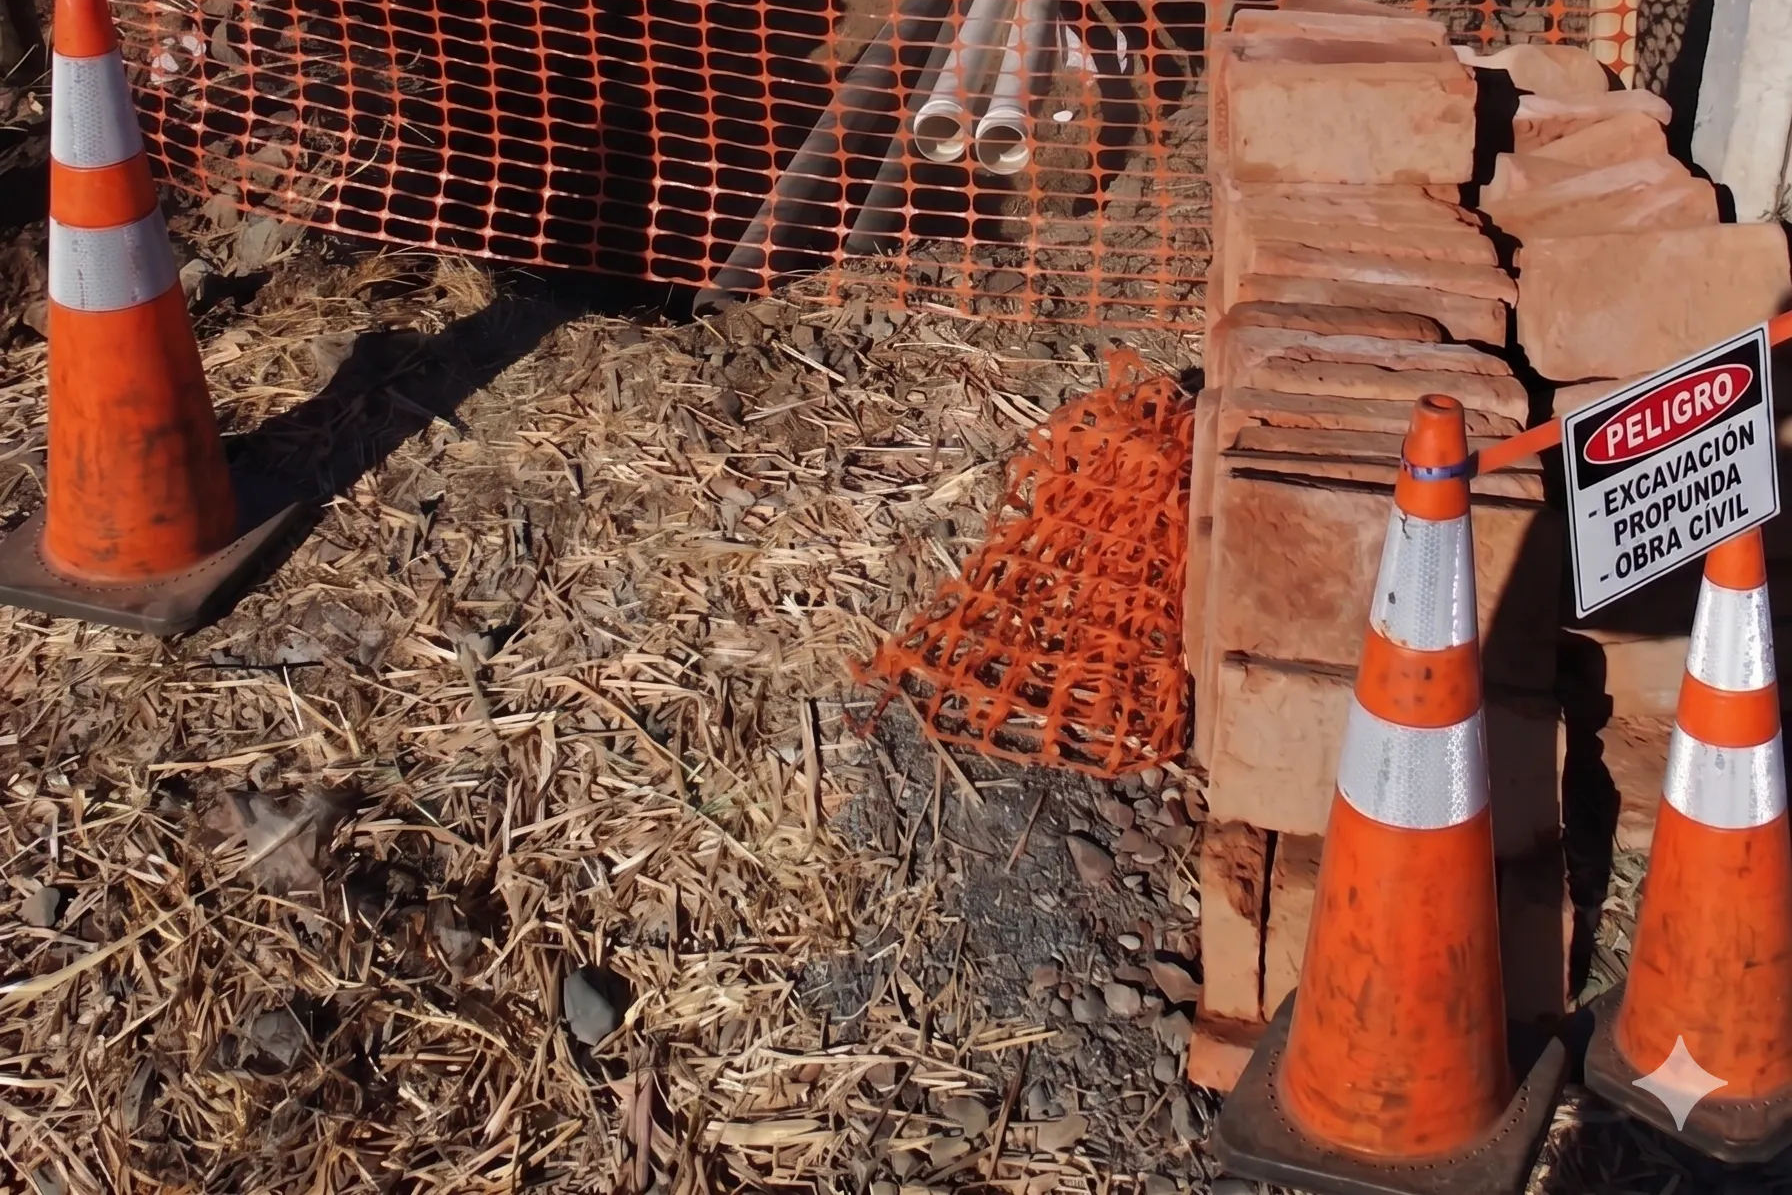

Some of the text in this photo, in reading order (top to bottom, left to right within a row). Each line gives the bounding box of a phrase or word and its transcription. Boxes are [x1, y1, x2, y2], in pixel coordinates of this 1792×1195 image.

[1606, 372, 1733, 458] PELIGRO
[1603, 420, 1755, 517] EXCAVACIÓN
[1615, 526, 1683, 579] OBRA
